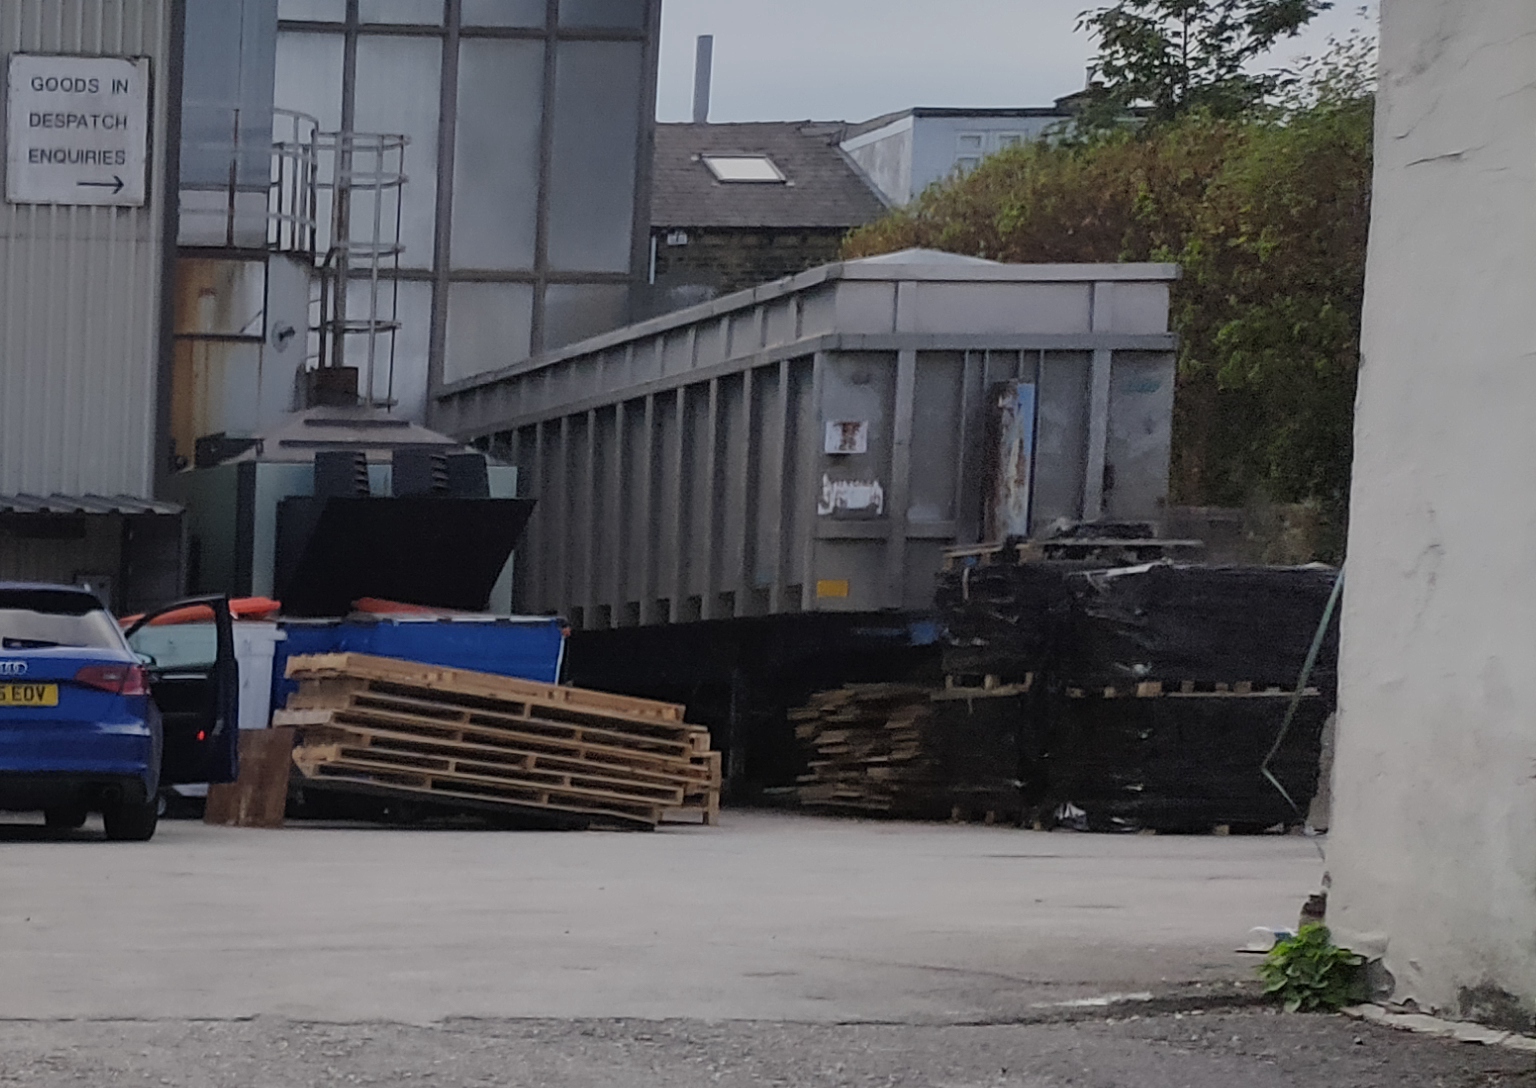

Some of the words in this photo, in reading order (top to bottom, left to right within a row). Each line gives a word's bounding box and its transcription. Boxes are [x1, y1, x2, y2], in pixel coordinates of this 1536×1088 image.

[31, 77, 100, 94] GOODS
[112, 79, 128, 94] IN
[29, 112, 127, 130] DESPATCH
[28, 148, 126, 165] ENQUIRIES
